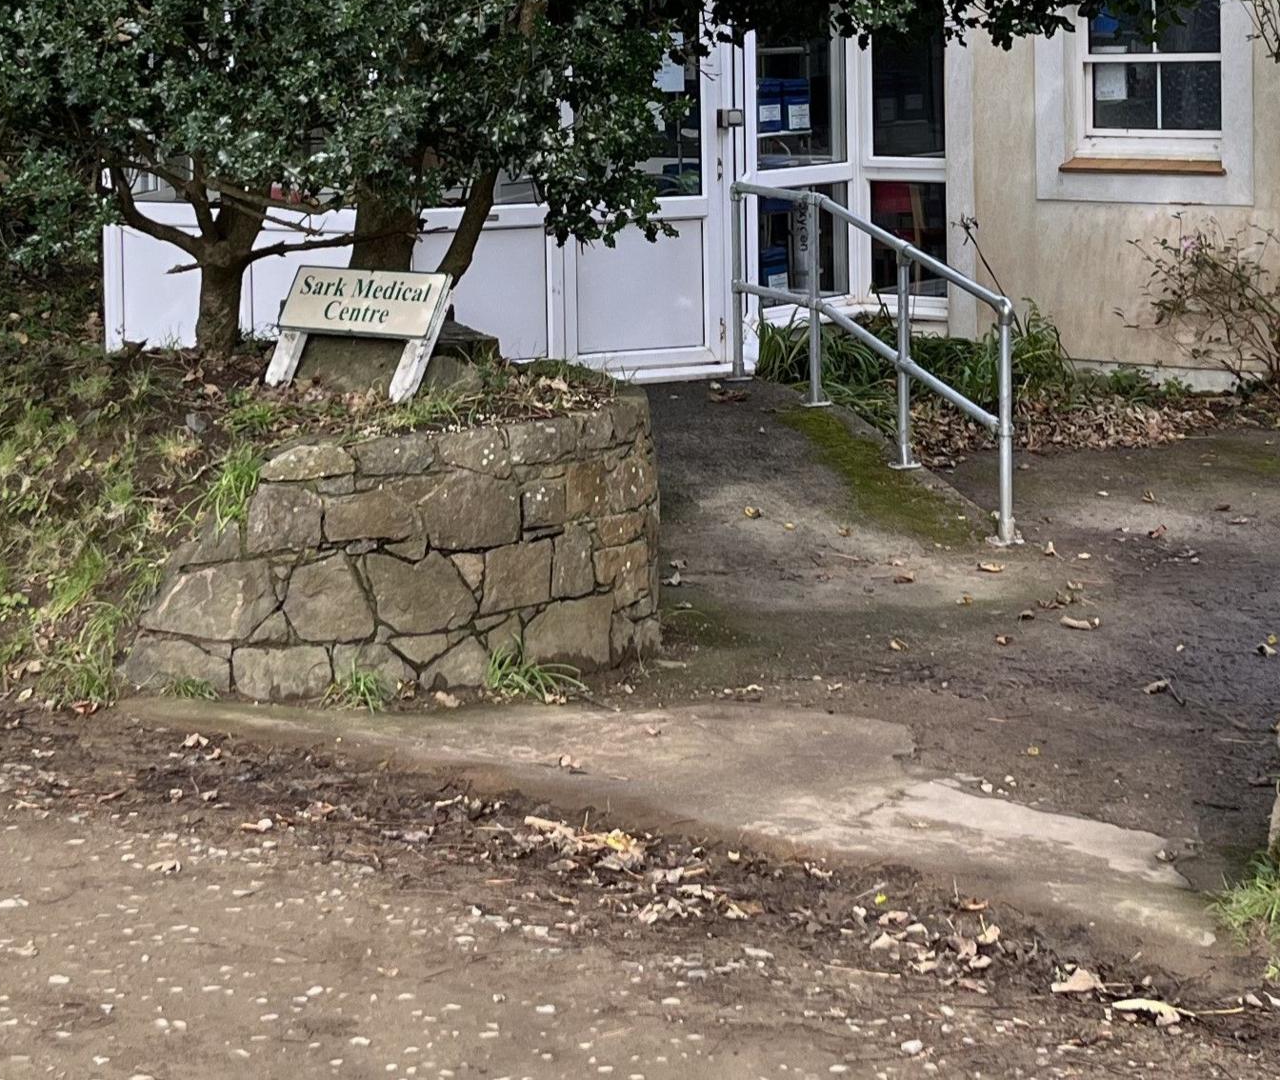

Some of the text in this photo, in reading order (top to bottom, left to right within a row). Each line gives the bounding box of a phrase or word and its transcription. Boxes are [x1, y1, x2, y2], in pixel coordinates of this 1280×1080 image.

[300, 275, 432, 303] Sark Medical
[324, 301, 390, 324] Centre
